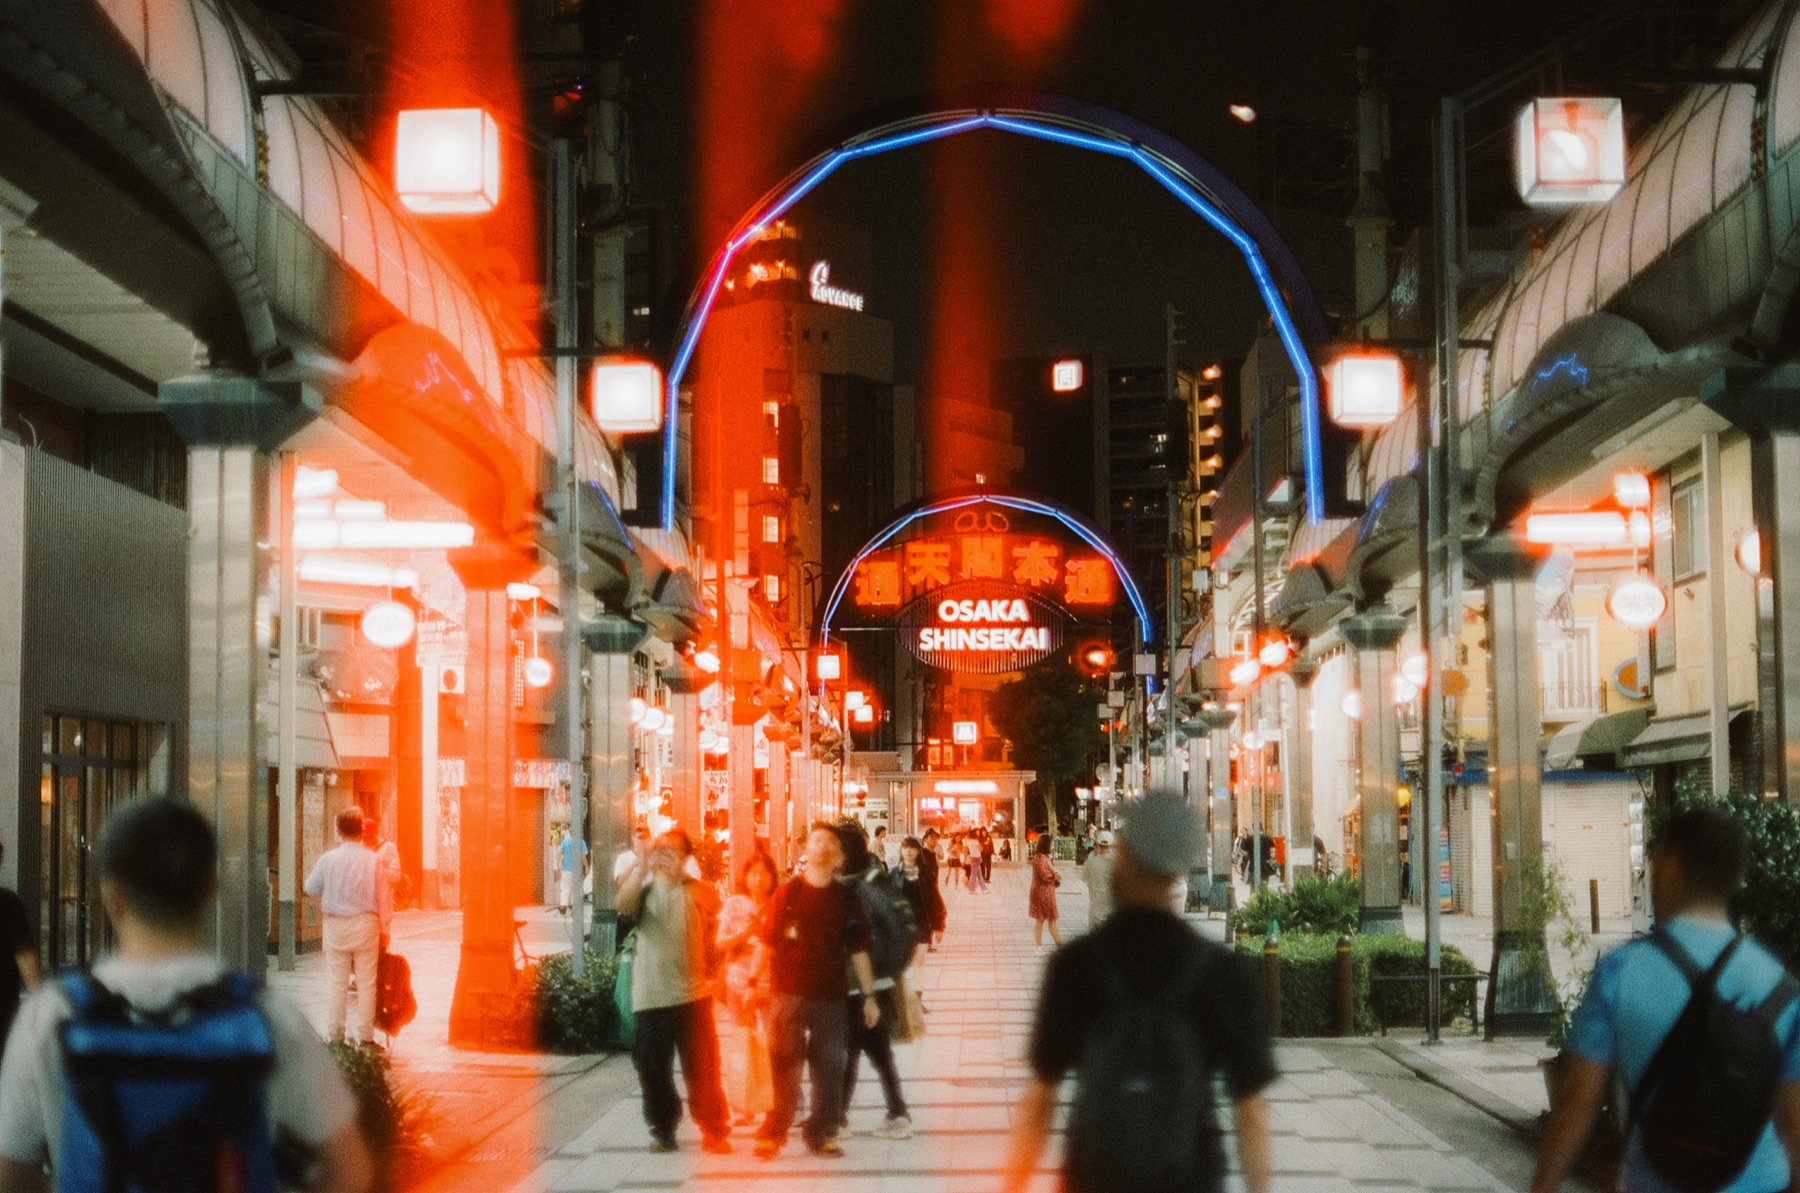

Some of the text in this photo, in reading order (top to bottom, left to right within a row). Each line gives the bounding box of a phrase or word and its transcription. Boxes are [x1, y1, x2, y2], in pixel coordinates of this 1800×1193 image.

[812, 285, 863, 311] ADVANCE
[855, 536, 1110, 605] 通天閣本通
[938, 599, 1029, 622] OSAKA
[919, 628, 1049, 651] SHINSEKAI
